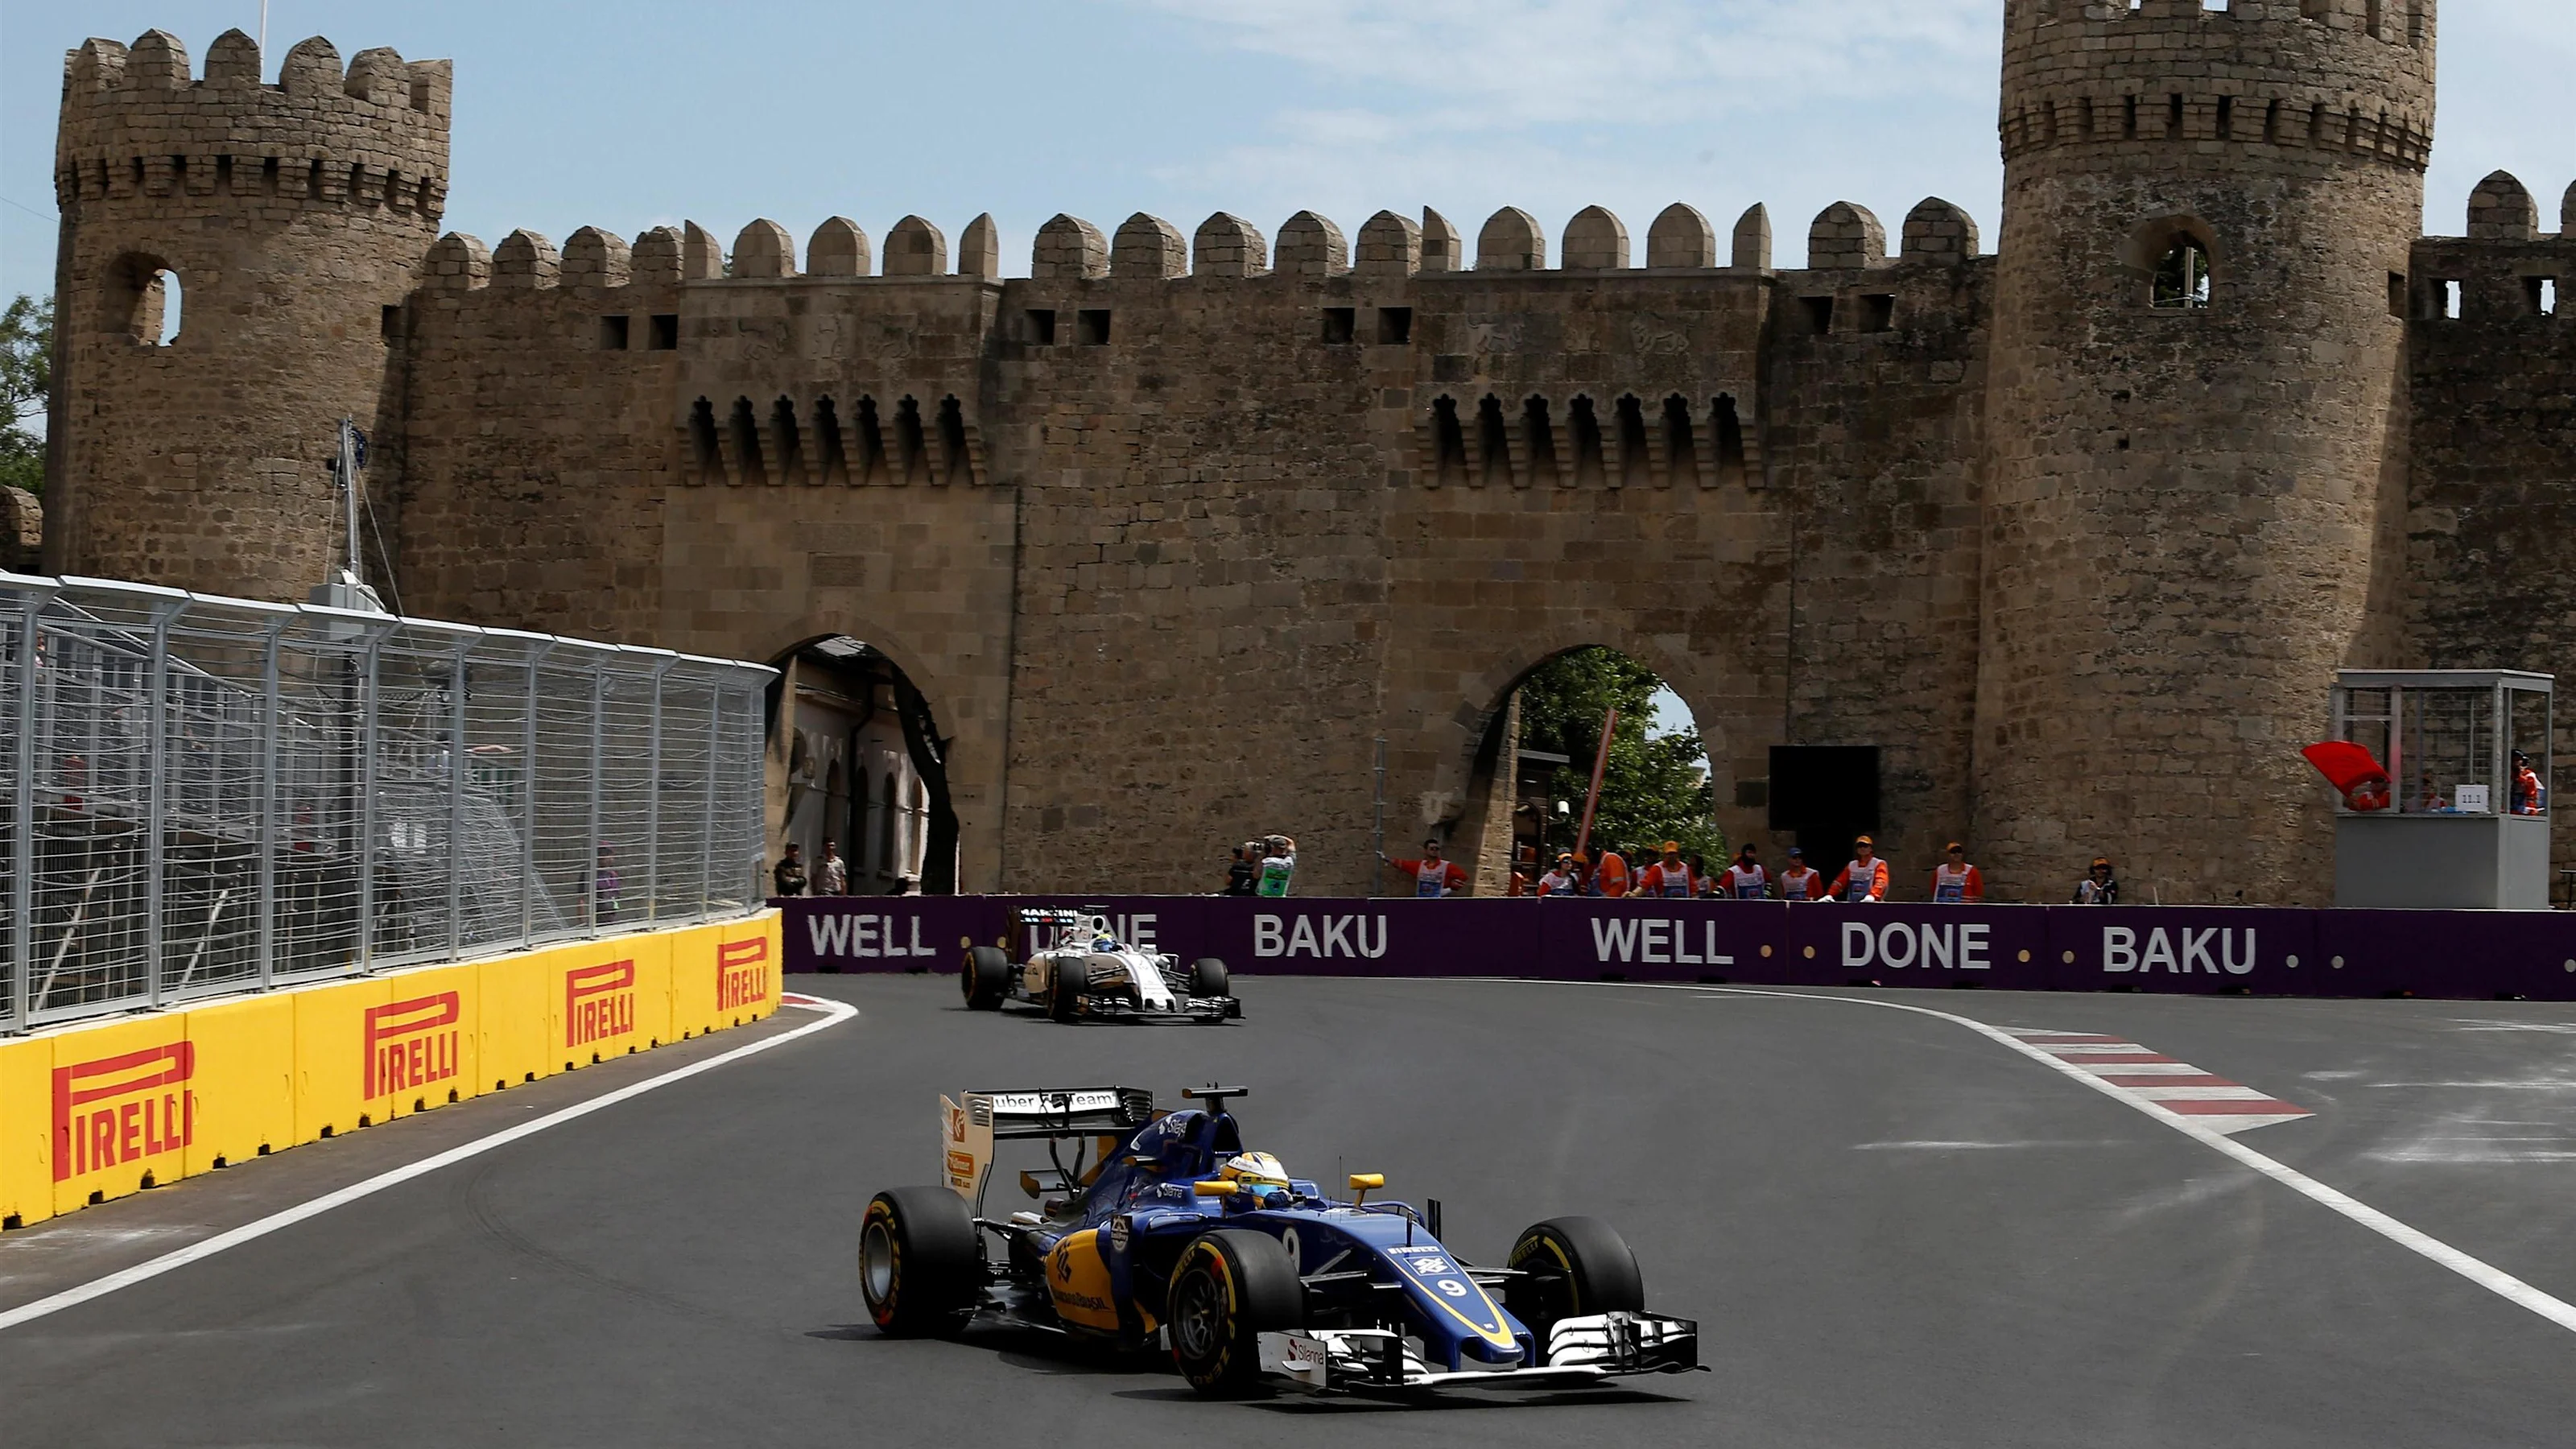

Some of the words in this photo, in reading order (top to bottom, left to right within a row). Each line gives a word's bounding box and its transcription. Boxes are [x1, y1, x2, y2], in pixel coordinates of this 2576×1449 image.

[2462, 795, 2481, 803] 11.1
[807, 914, 936, 957] WELL
[1030, 914, 1158, 956] DNE
[1254, 914, 1387, 958] BAKU
[1591, 917, 1734, 964] WELL
[1842, 922, 1991, 968] DONE
[2103, 926, 2256, 975] BAKU
[717, 937, 766, 1011] PIRELLI
[567, 960, 634, 1047] PIRELLI
[365, 991, 459, 1100] PIRELLI
[52, 1040, 195, 1183] PIRELLI
[993, 1094, 1034, 1108] uber
[1069, 1092, 1113, 1105] Team
[1436, 1279, 1468, 1297] 9
